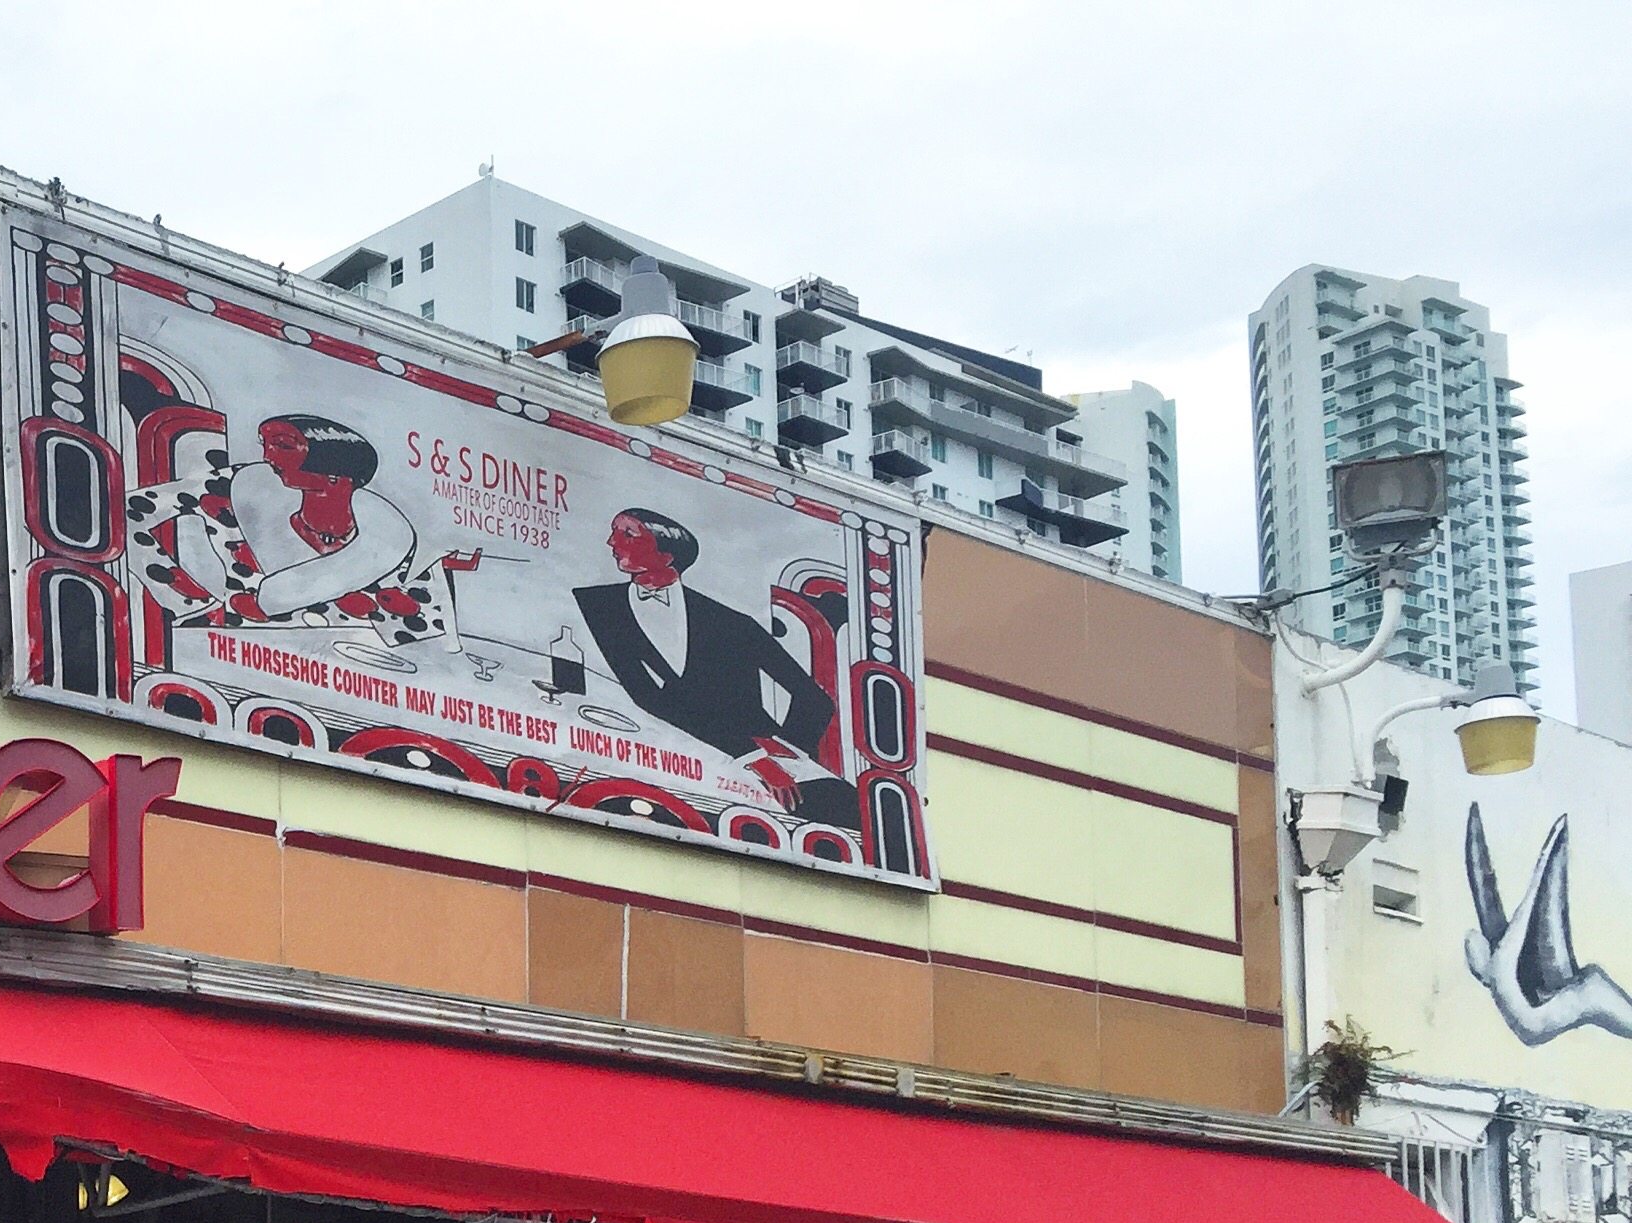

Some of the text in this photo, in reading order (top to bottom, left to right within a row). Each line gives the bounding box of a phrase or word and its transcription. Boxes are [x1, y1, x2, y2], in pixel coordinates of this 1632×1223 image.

[408, 431, 569, 512] S & S DINER
[453, 505, 550, 549] SINCE 1938
[483, 492, 496, 512] OF
[498, 496, 530, 521] GOOD
[532, 505, 561, 531] TASTE
[208, 631, 703, 781] THE HORSESHOE COUNTER MAY JUST BE THE BEST LUNCH OF THE WORLD
